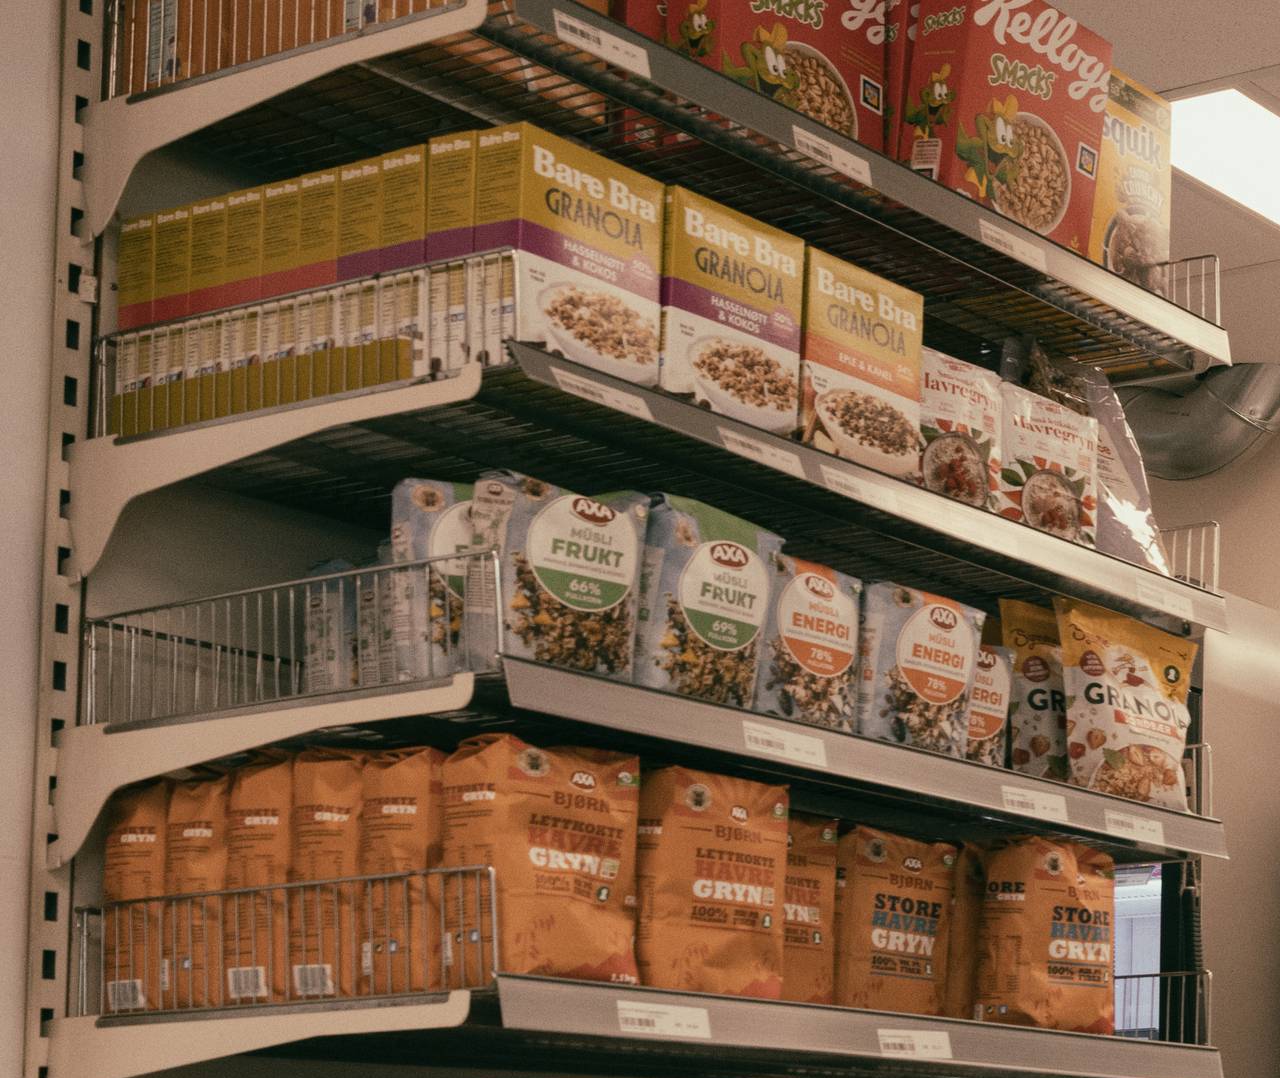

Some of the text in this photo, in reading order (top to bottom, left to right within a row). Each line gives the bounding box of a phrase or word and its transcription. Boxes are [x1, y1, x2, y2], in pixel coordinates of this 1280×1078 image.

[1103, 110, 1164, 172] squik
[532, 144, 657, 224] Bare Bra
[545, 187, 643, 251] GRANOLA
[683, 207, 797, 279] Bare Bra
[694, 246, 785, 304] GRANOLA
[815, 266, 919, 334] Bare Bra
[826, 302, 907, 358] GRANOLA
[574, 498, 612, 522] AXA
[551, 537, 625, 569] FRUKT
[711, 543, 748, 564] AXA
[700, 581, 757, 611] FRUKT
[807, 574, 834, 597] AXA
[791, 611, 851, 642] ENERGI
[930, 605, 958, 630] AXA
[911, 641, 966, 671] ENERGI
[972, 688, 1004, 707] ERGI
[552, 790, 611, 815] BJØRN
[529, 813, 624, 840] LETTKOKTE
[528, 847, 600, 876] GRYN
[695, 848, 775, 868] LETTKOKTE
[694, 860, 774, 884] HAVRE
[888, 872, 935, 892] BJØRN
[692, 879, 763, 905] GRYN
[987, 880, 1026, 894] ORE
[873, 893, 943, 920] STORE
[1051, 905, 1110, 925] STORE
[872, 911, 939, 936] HAVRE
[870, 927, 936, 957] GRYN
[1048, 939, 1111, 963] GRYN
